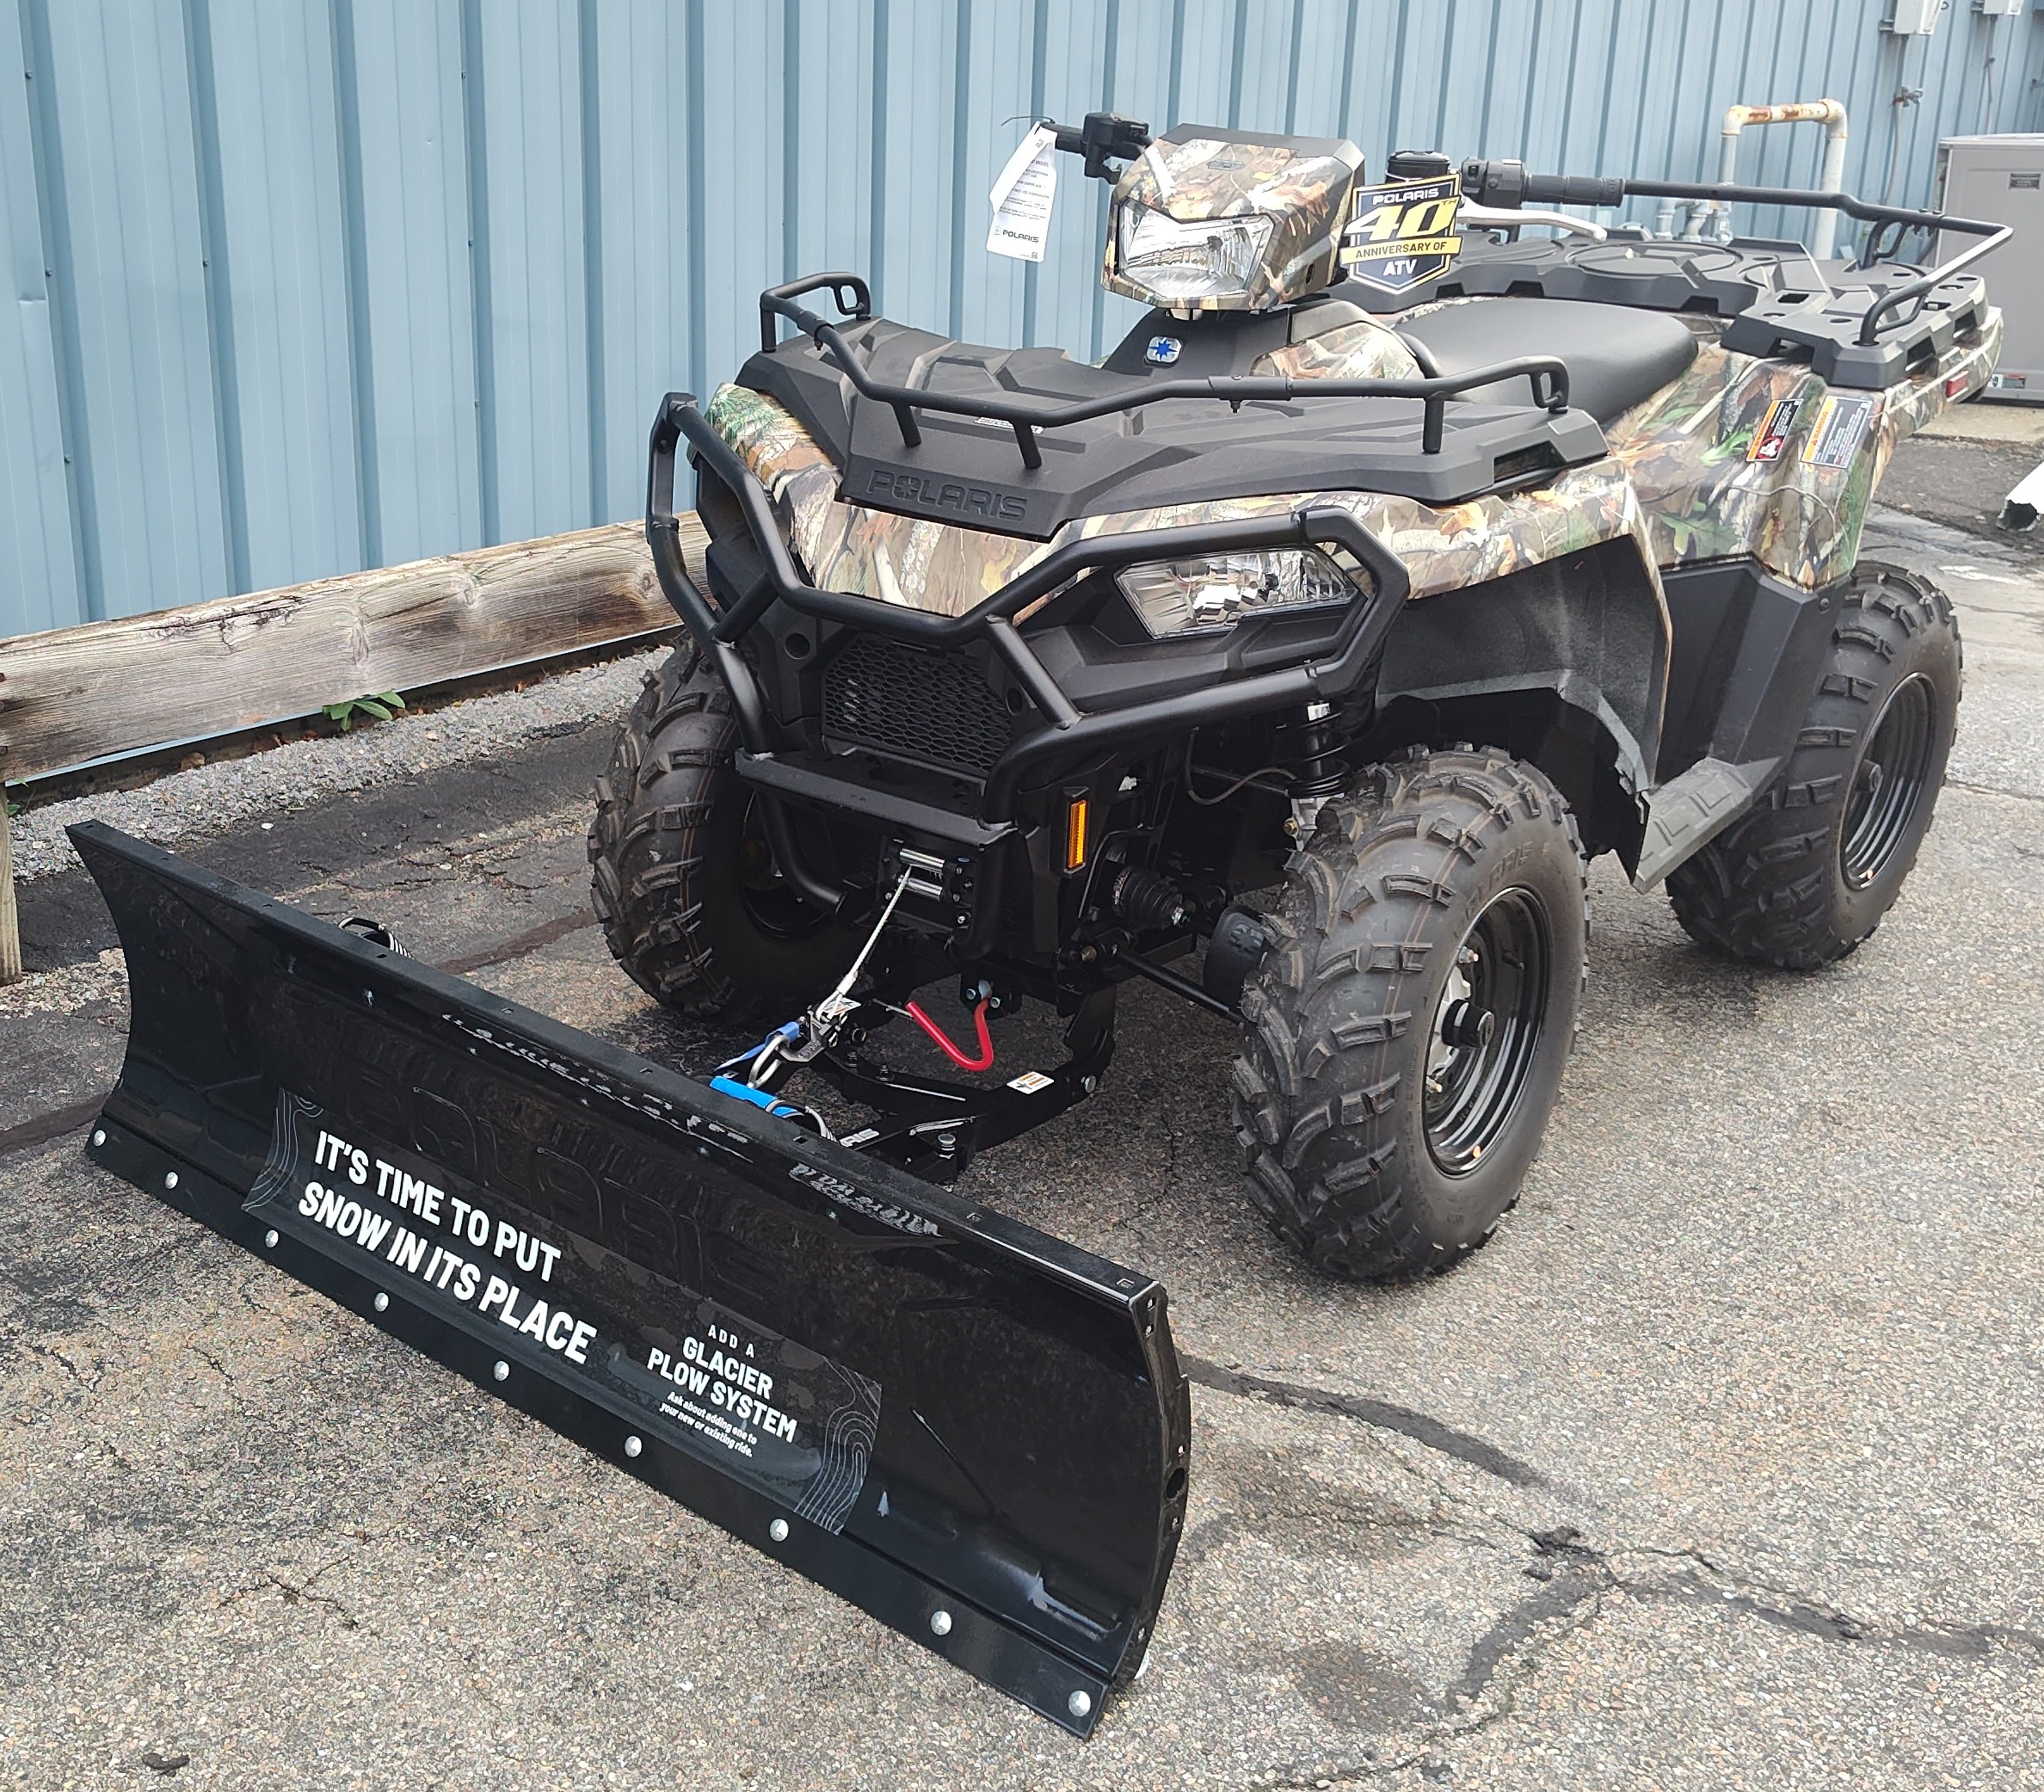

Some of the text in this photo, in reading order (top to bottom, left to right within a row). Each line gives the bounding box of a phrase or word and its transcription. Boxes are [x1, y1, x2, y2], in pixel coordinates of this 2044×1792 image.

[1372, 188, 1439, 206] POLARIS
[1002, 229, 1039, 243] POLARIS
[1355, 242, 1448, 259] ANNIVERSARY OF
[1382, 259, 1418, 276] ATV
[866, 469, 1028, 521] POLARIS
[315, 1130, 562, 1282] IT'S TIME TO PUT
[299, 1181, 598, 1364] SNOW IN ITS PLACE
[707, 1324, 755, 1358] ADD A
[682, 1336, 773, 1400] GLACIER
[647, 1347, 797, 1444] PLOW SYSTEM
[667, 1391, 758, 1445] Ask about adding one to
[659, 1402, 754, 1457] your new or existing ride.
